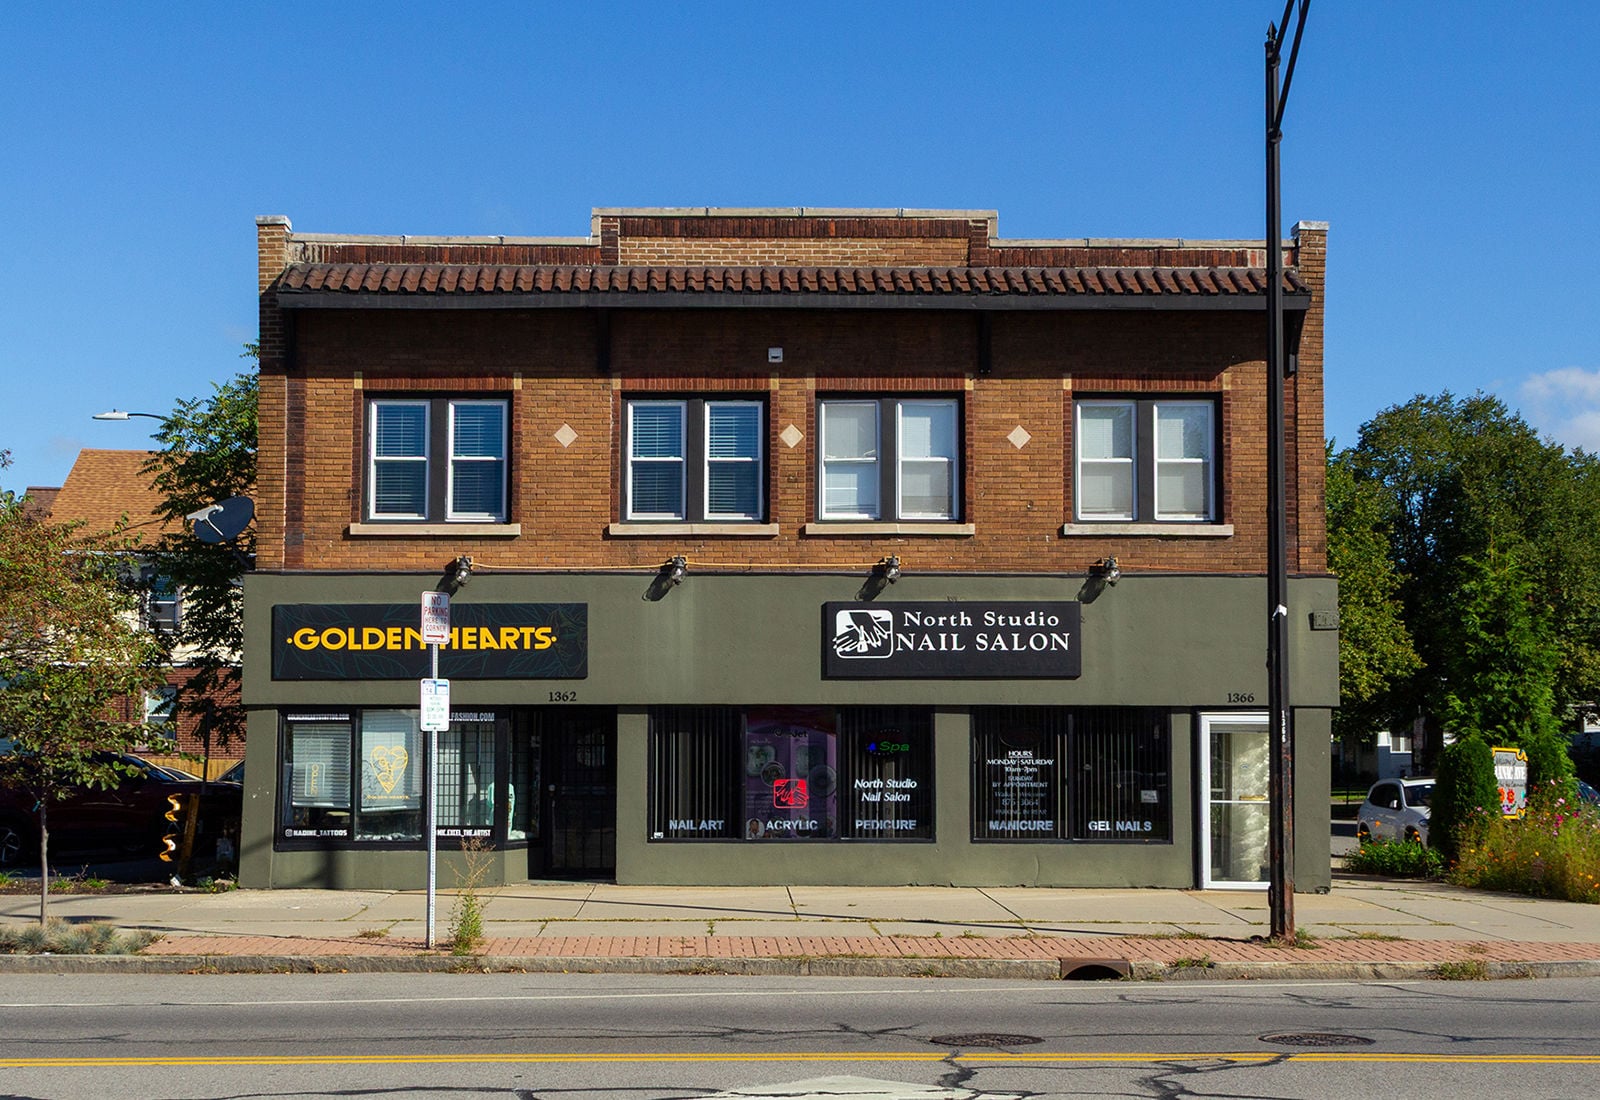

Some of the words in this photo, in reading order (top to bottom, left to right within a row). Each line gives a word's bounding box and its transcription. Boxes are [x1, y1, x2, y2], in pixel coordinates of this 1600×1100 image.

[431, 595, 442, 606] NO
[424, 606, 448, 616] PARKING
[425, 616, 438, 624] HERE
[440, 616, 448, 624] TO
[903, 611, 973, 627] North
[984, 611, 1060, 627] Studio
[426, 624, 447, 632] CORNER
[293, 627, 427, 650] GOLDEN
[439, 627, 552, 650] HEARTS
[895, 633, 966, 651] NAIL
[975, 633, 1070, 651] SALON
[548, 691, 577, 702] 1362
[1226, 692, 1255, 703] 1366
[879, 741, 910, 753] Spa
[854, 778, 883, 789] North
[885, 778, 918, 789] Studio
[861, 791, 881, 802] Nail
[883, 791, 911, 802] Salon
[668, 820, 697, 830] NAIL
[698, 820, 724, 830] ART
[765, 820, 818, 831] ACRYLIC
[855, 820, 917, 830] PEDICURE
[989, 821, 1053, 831] MANICURE
[1088, 821, 1111, 831] GEL
[1116, 821, 1152, 831] NAILS
